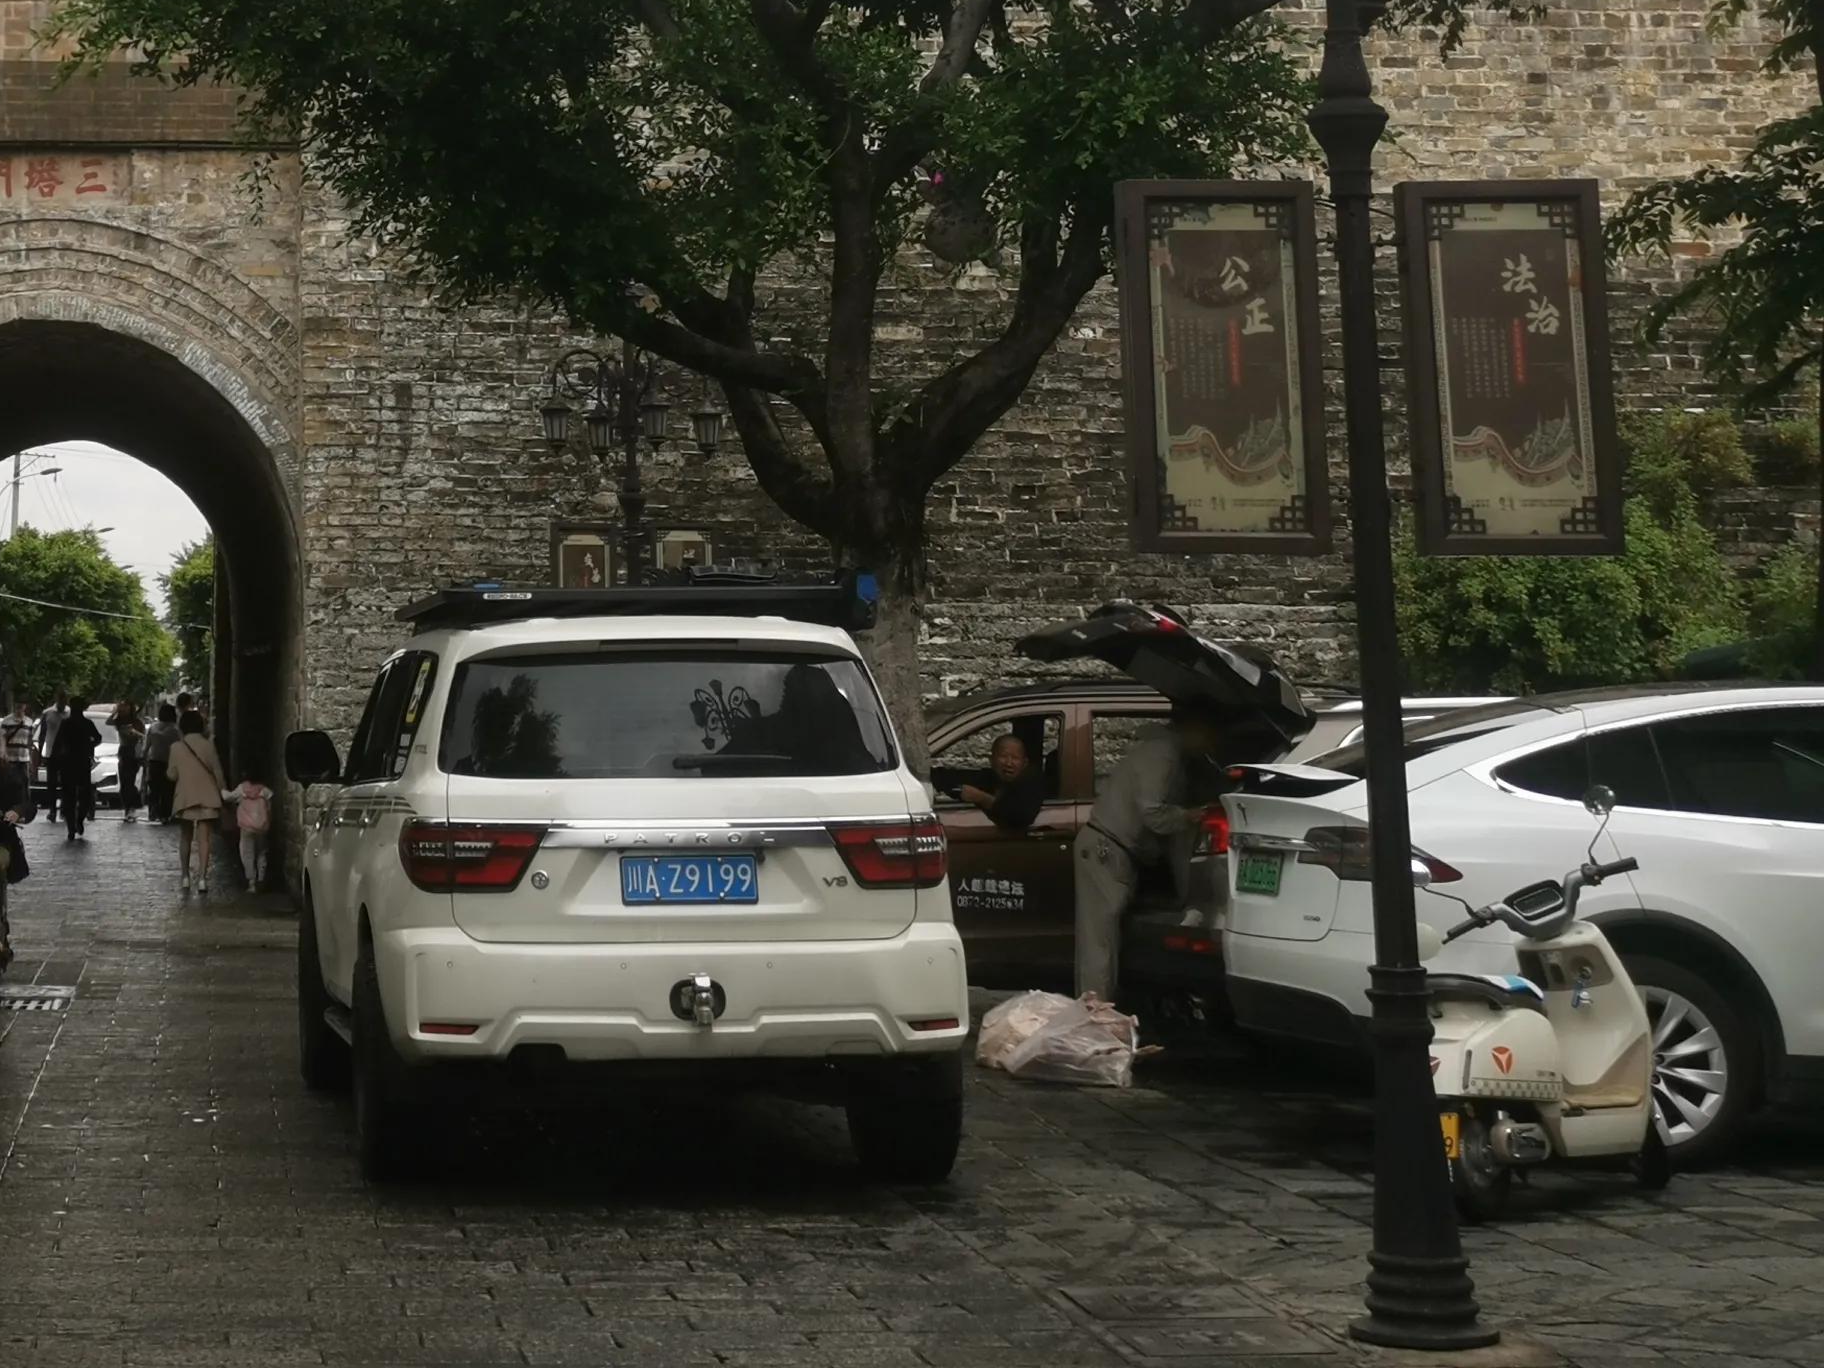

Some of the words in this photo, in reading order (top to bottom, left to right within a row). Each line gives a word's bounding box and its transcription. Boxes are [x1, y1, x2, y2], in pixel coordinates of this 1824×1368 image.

[1219, 255, 1275, 336] 公正
[1500, 253, 1561, 336] 法治
[604, 831, 775, 845] PATROL
[822, 875, 849, 888] V8
